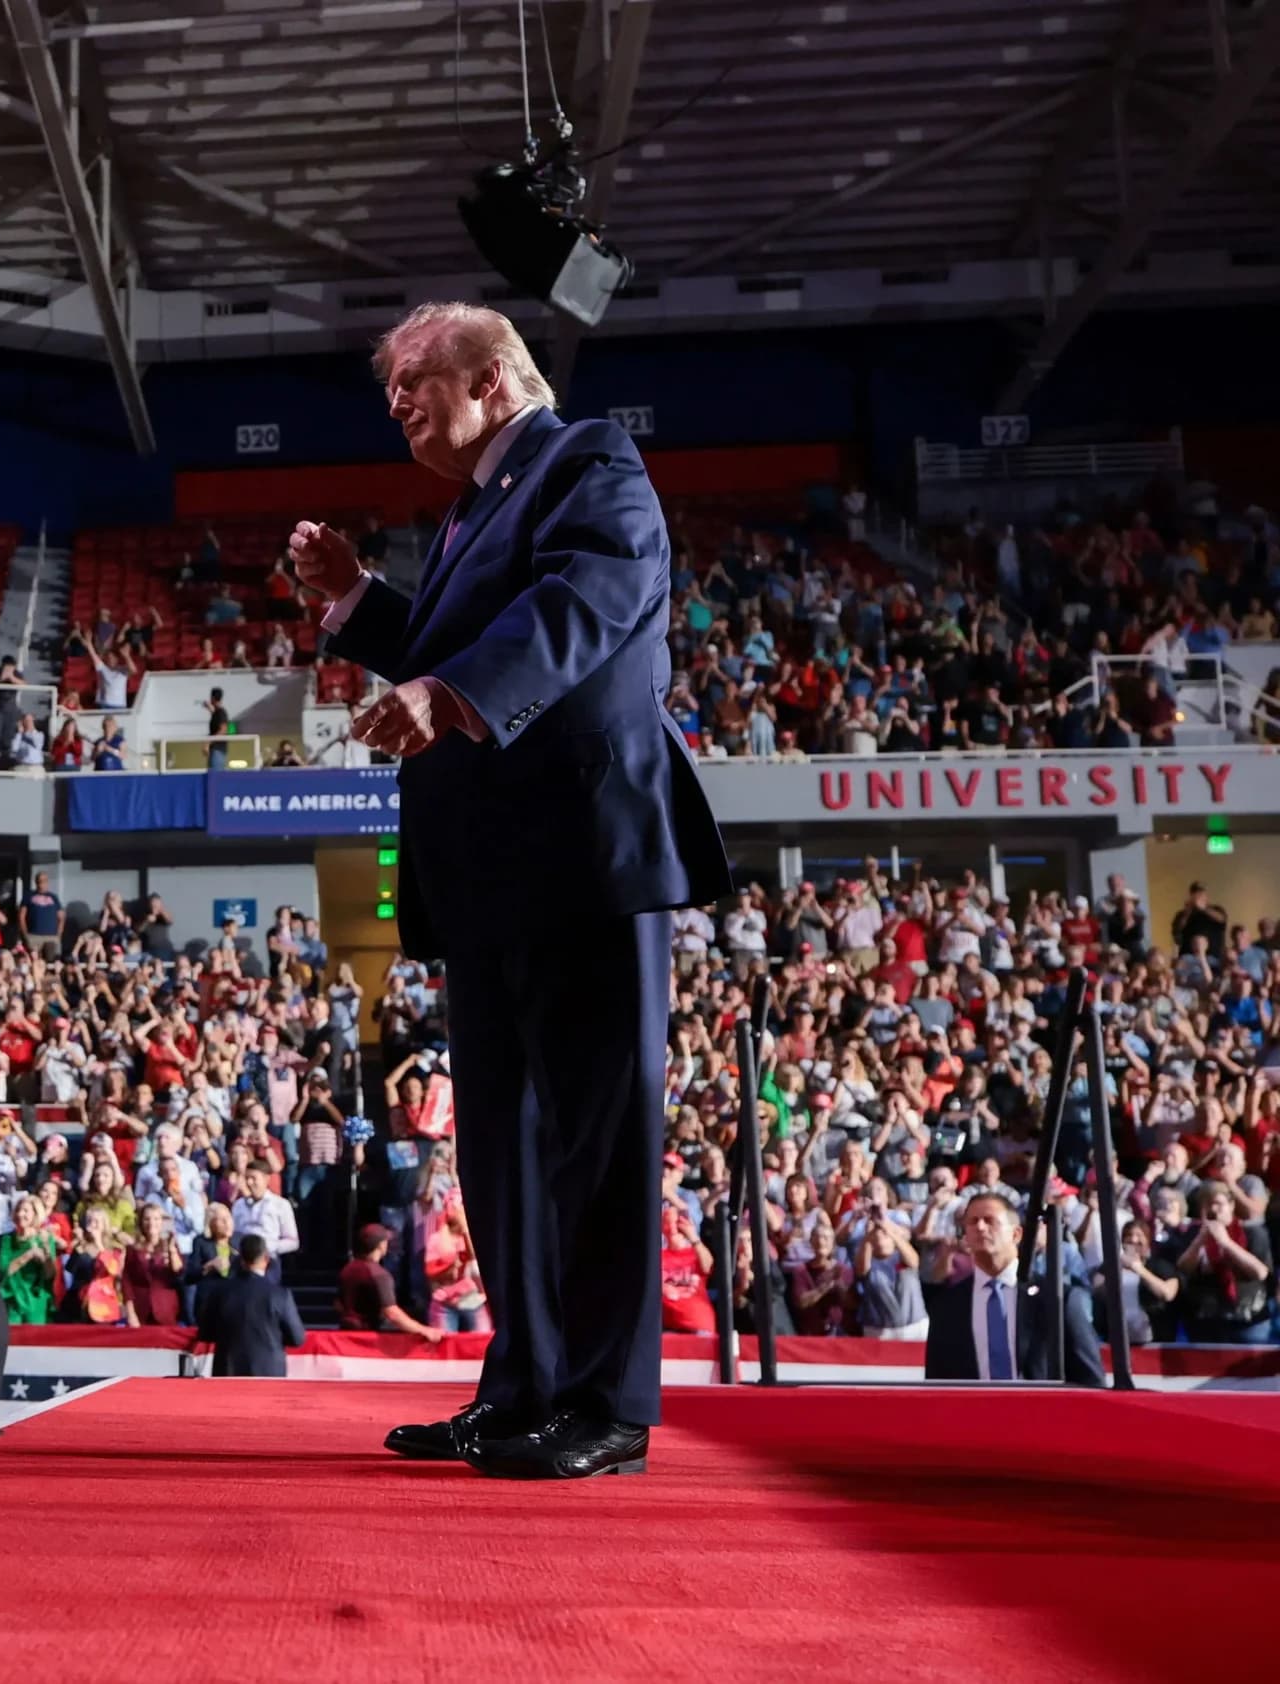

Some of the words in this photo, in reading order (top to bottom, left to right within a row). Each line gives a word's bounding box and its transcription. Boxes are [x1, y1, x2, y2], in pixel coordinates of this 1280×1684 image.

[238, 427, 280, 448] 320
[820, 765, 1232, 811] UNIVERSITY
[223, 795, 282, 811] MAKE
[287, 793, 383, 810] AMERICA
